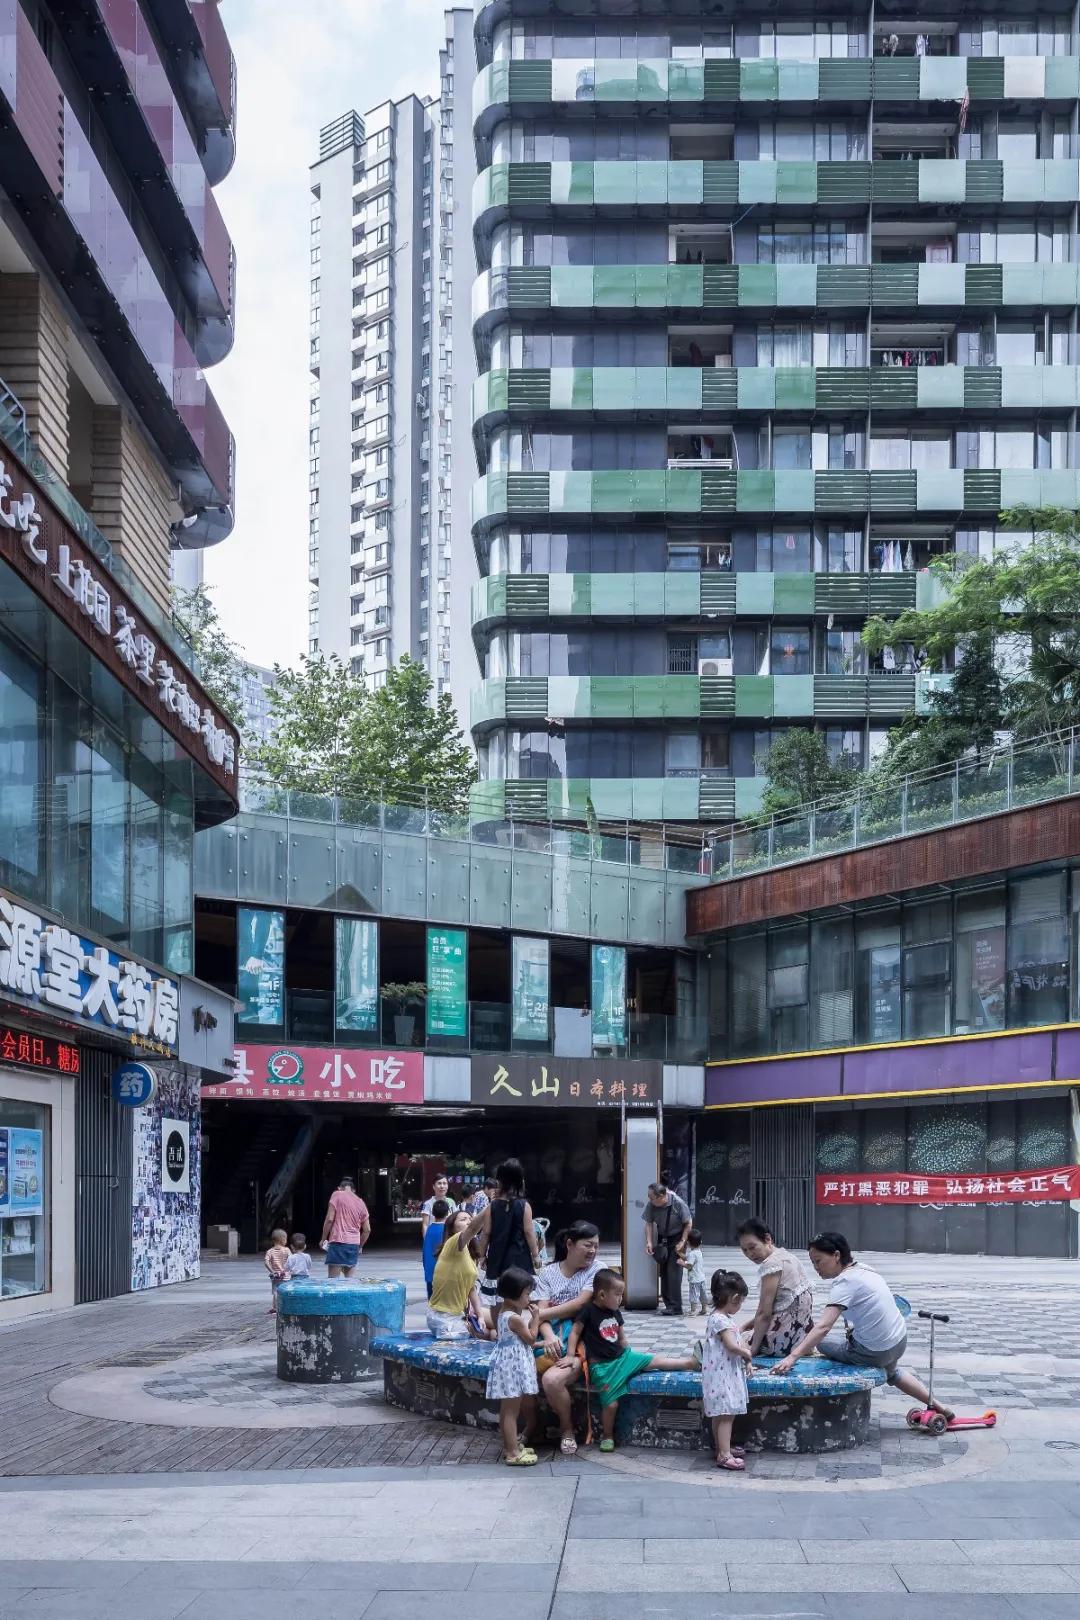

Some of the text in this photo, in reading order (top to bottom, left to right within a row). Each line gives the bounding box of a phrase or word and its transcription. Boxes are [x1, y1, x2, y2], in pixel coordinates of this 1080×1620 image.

[0, 896, 179, 1045] 源堂大药房
[119, 1071, 144, 1098] 药
[319, 1054, 406, 1090] 小吃
[490, 1064, 648, 1101] 久山 日本料理
[823, 1174, 1072, 1197] 严打黑恶犯罪 弘扬社会正气
